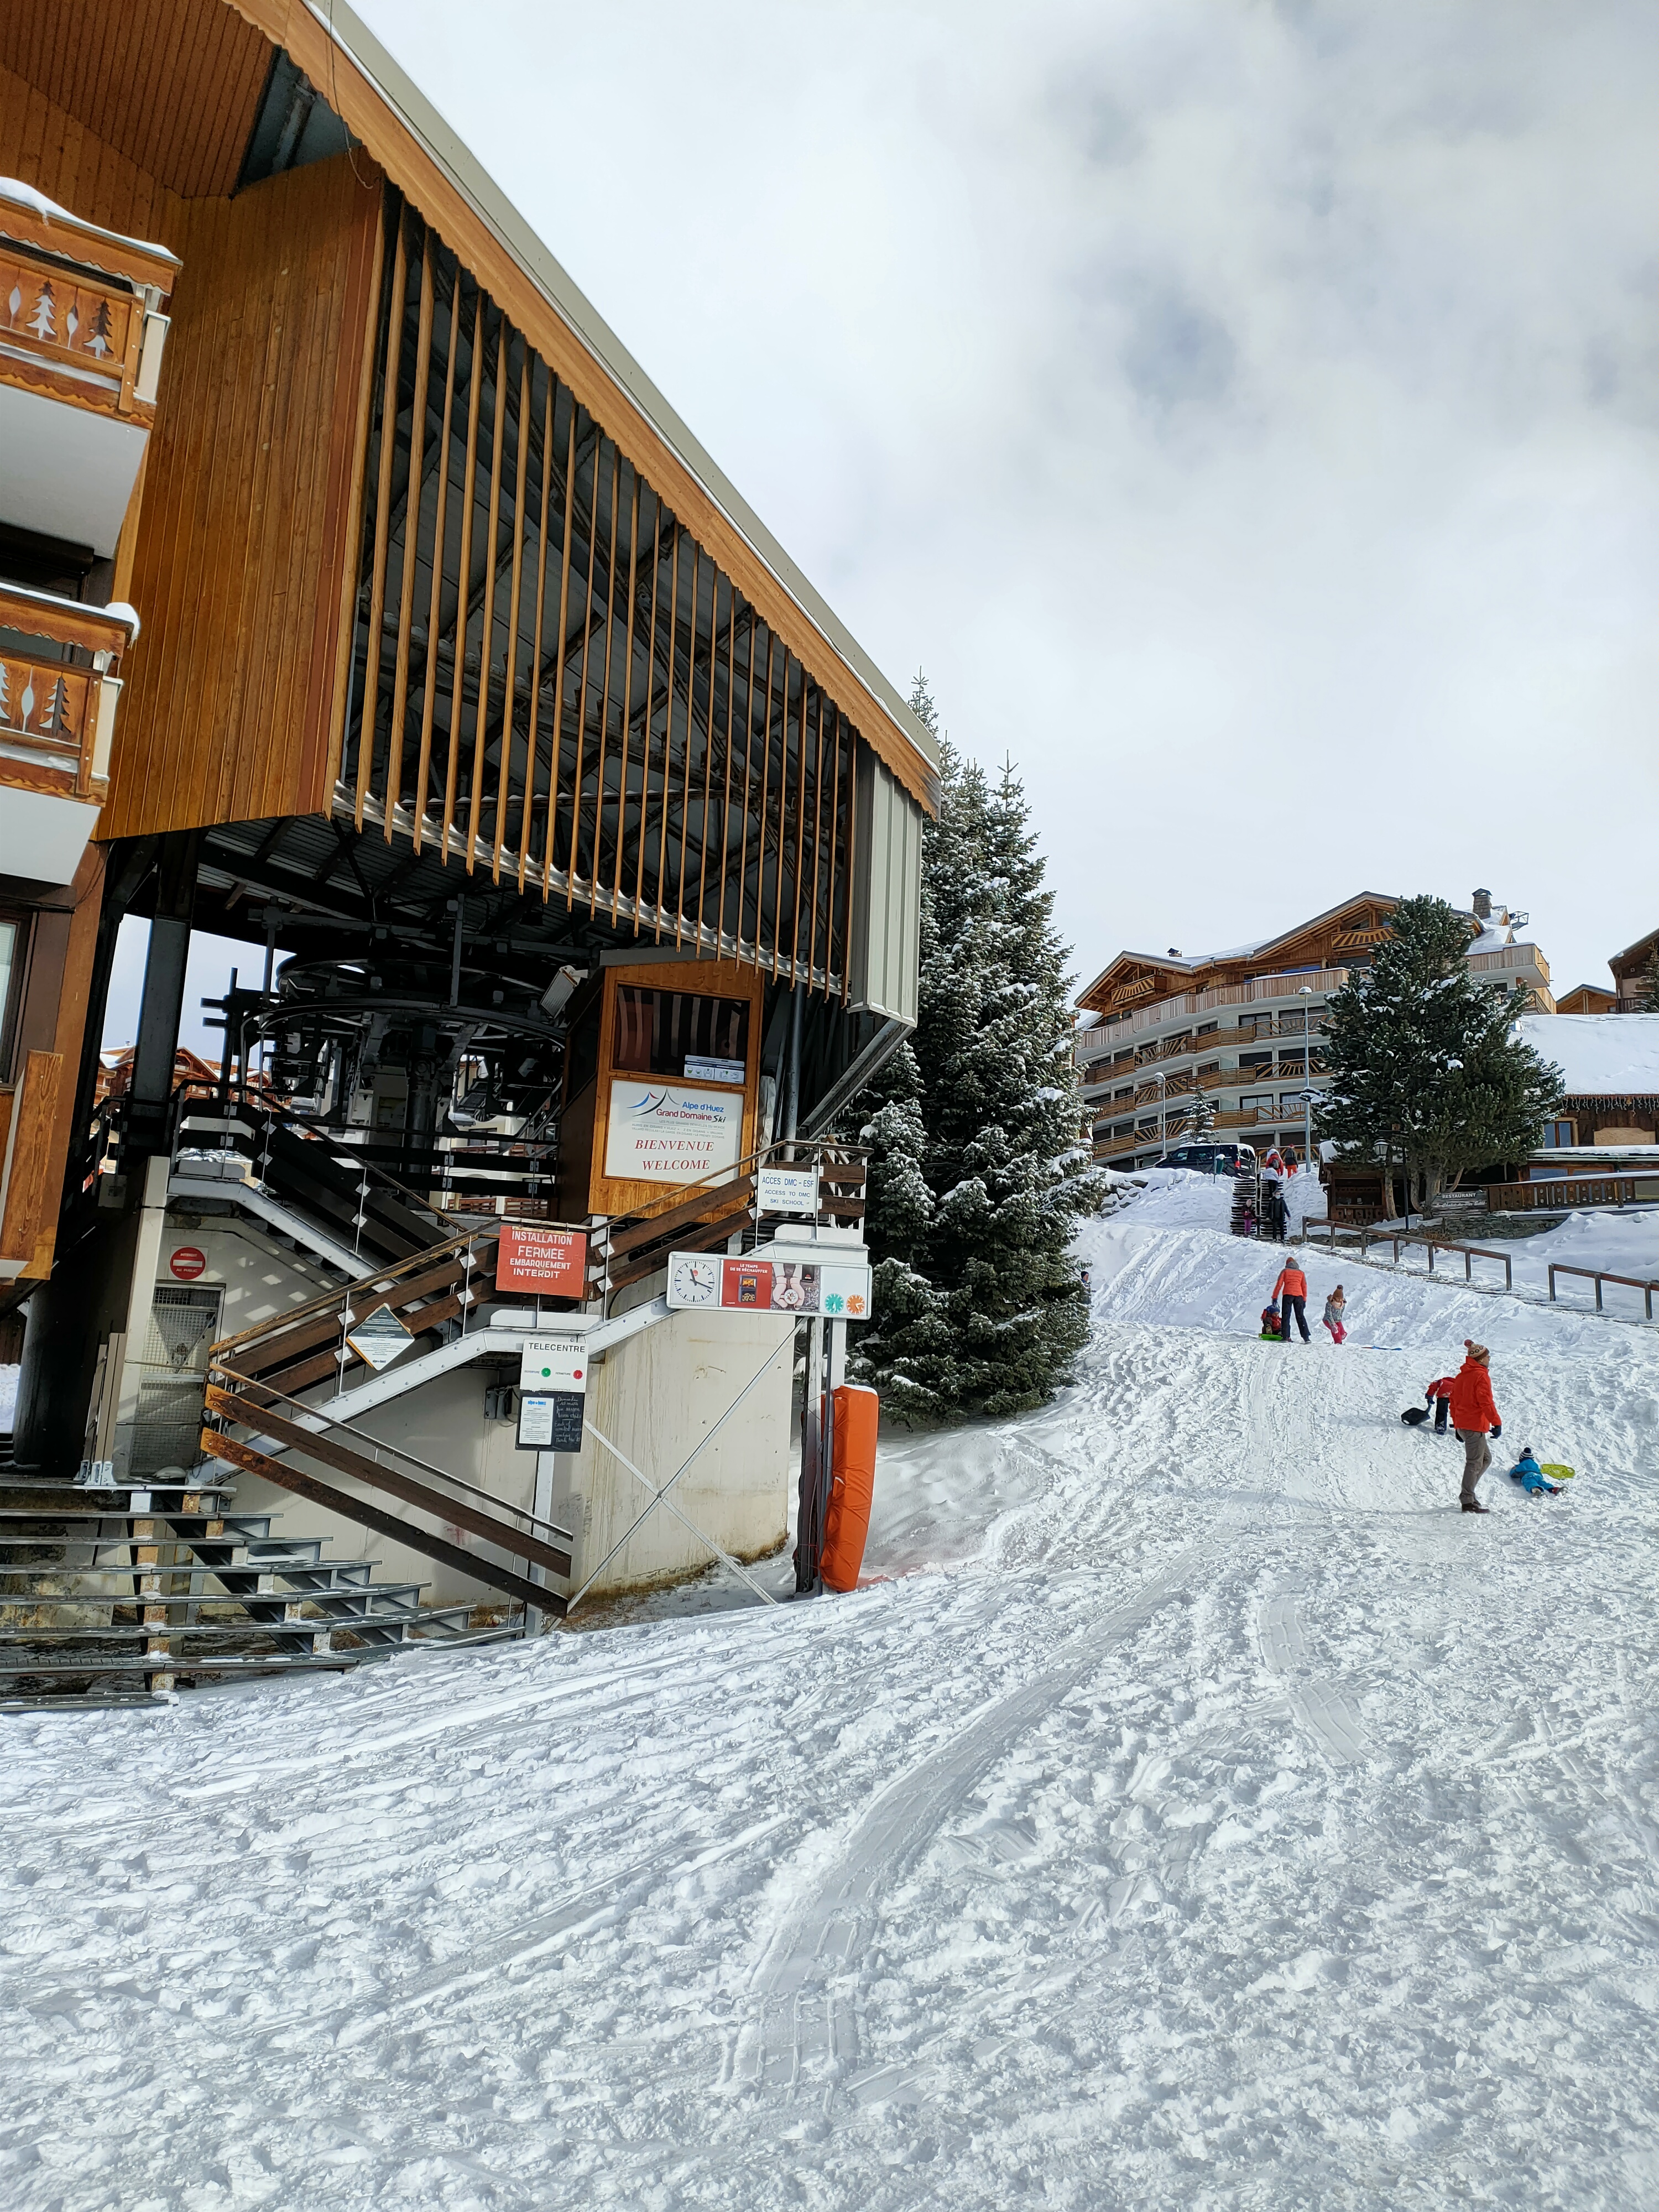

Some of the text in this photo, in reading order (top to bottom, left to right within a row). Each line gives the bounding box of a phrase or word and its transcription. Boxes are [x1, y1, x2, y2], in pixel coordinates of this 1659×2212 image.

[682, 1102, 724, 1113] Alpe d'Huez
[656, 1109, 679, 1117] Grand
[680, 1111, 712, 1120] Domaine
[634, 1139, 714, 1151] BIENVENUE
[642, 1160, 710, 1170] WELCOME
[761, 1176, 781, 1185] ACCES
[784, 1178, 797, 1186] DMC
[512, 1230, 572, 1245] INSTALLATION
[518, 1245, 565, 1260] FERMÉE
[510, 1258, 571, 1270] EMBARQUEMENT
[513, 1267, 560, 1279] INTERDIT
[528, 1342, 586, 1353] TELECENTRE
